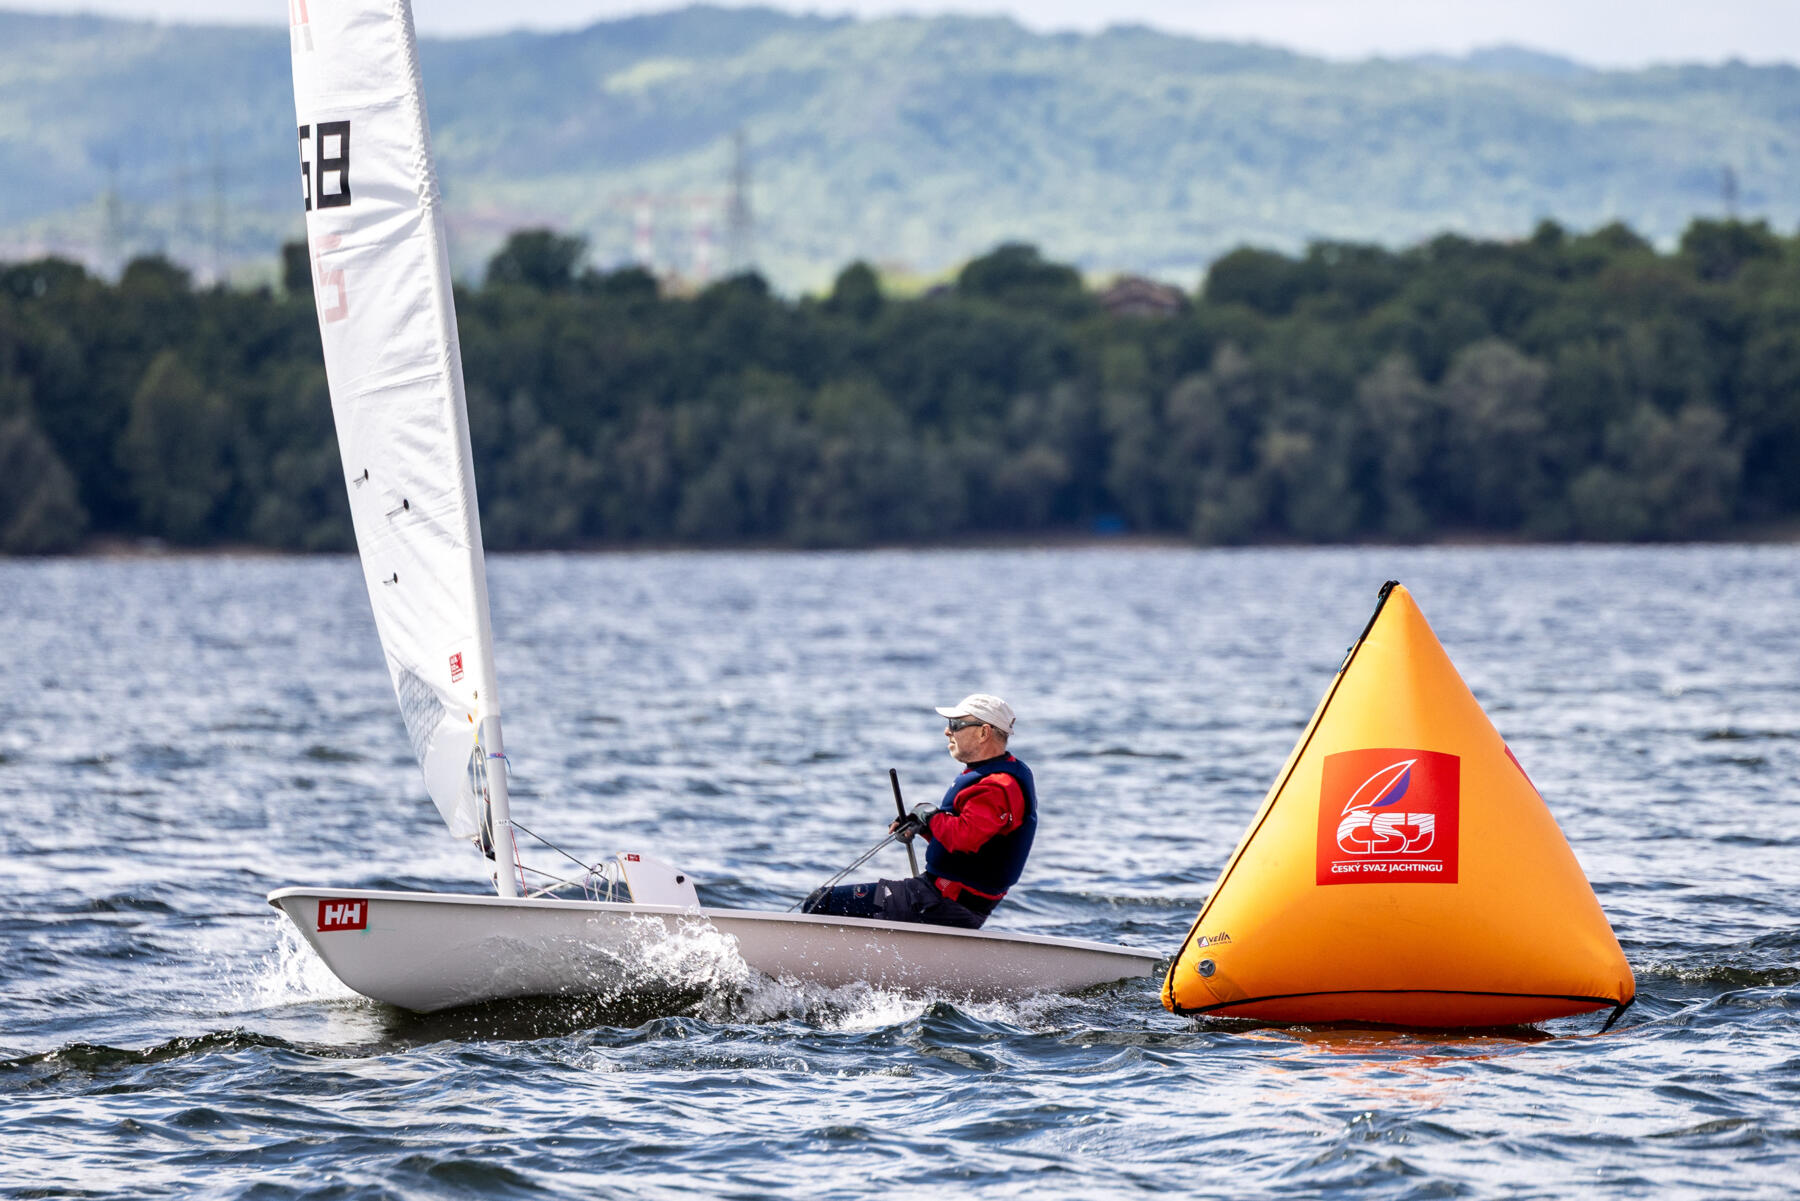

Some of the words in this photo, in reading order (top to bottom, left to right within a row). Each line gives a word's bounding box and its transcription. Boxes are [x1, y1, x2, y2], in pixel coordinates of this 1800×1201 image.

[1331, 862, 1360, 873] ČESKÝ
[1363, 863, 1387, 872] SVAZ
[1389, 863, 1443, 873] JACHTINGU
[324, 903, 361, 925] HH
